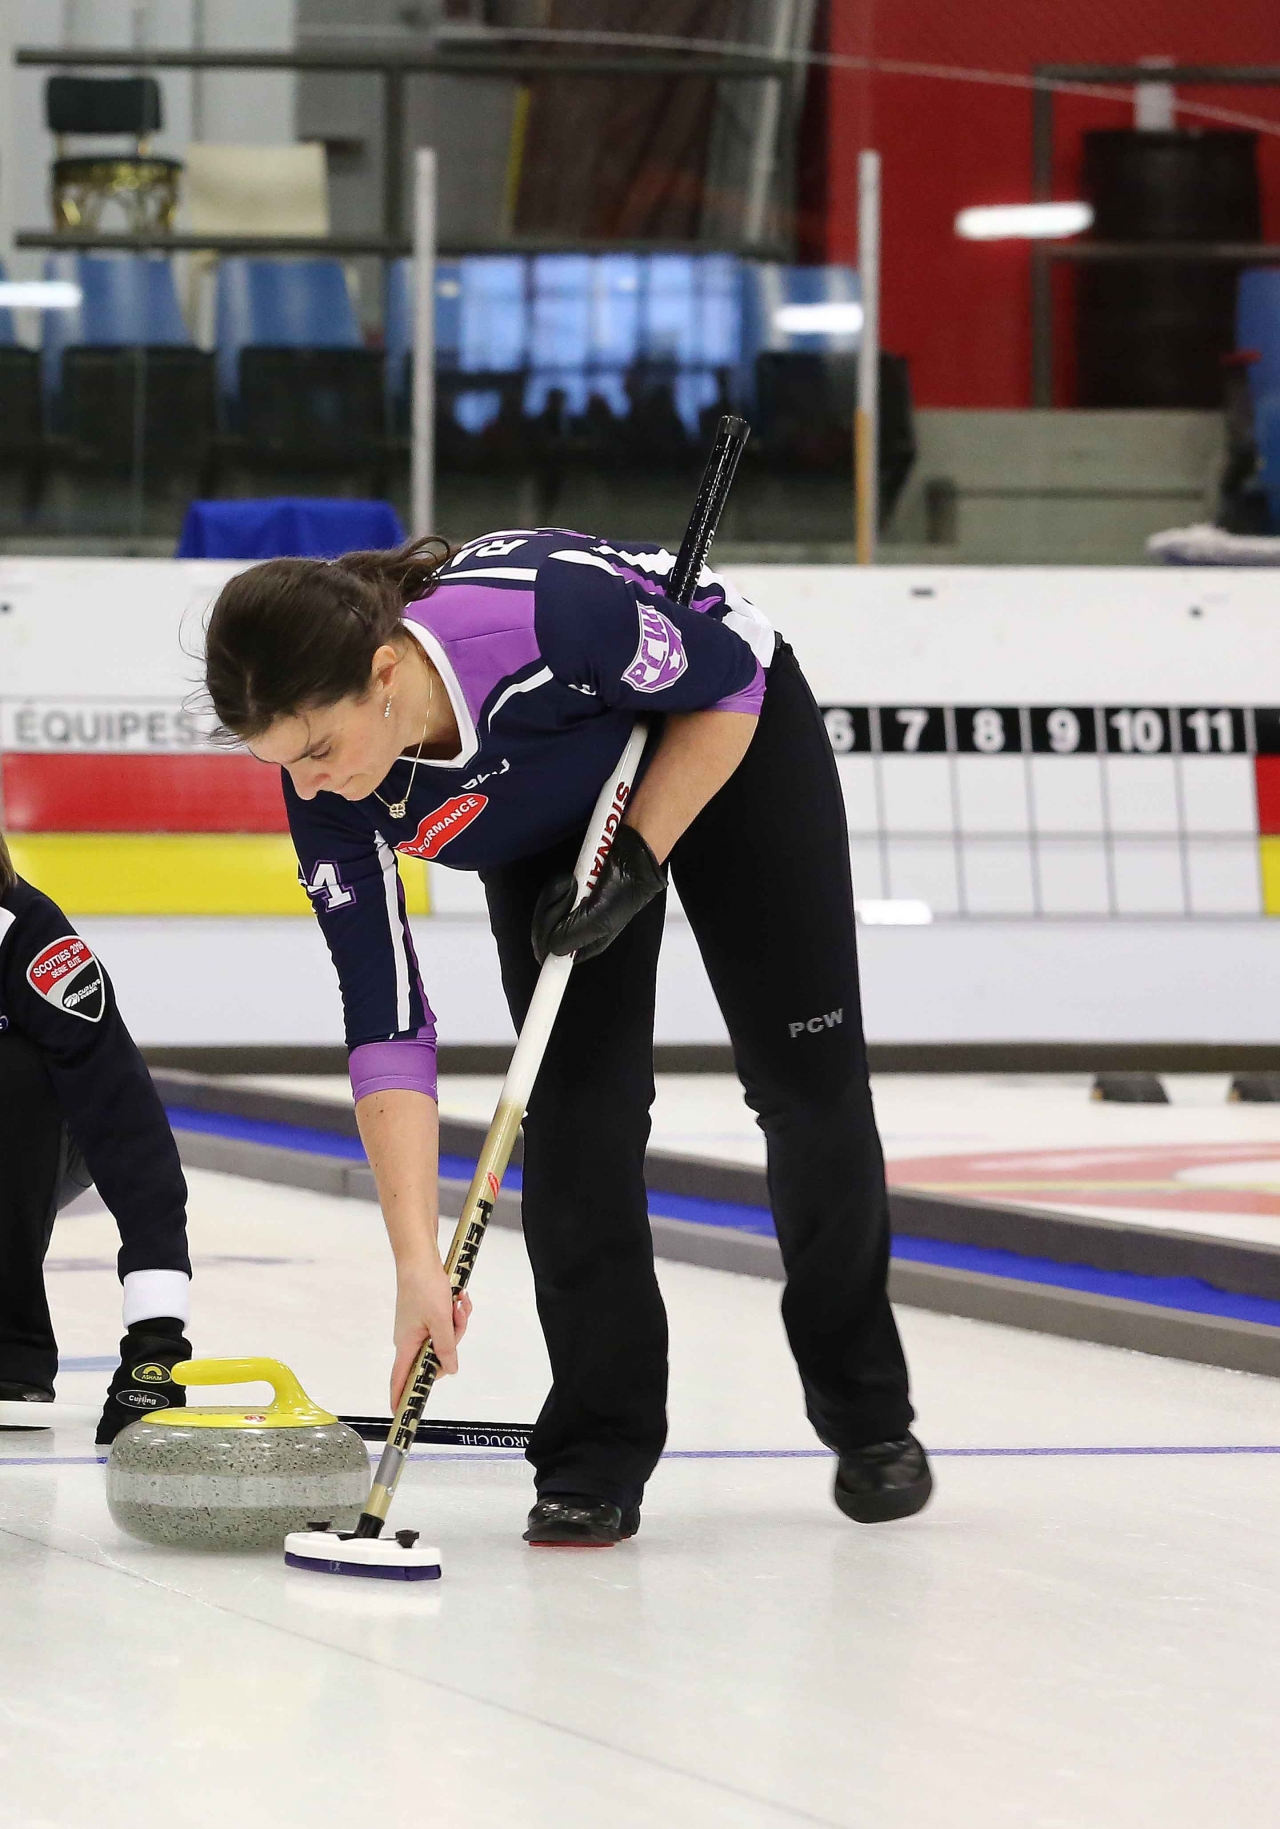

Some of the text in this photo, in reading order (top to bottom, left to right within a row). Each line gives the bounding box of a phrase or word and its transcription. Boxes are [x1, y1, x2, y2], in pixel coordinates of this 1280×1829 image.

[824, 708, 1235, 753] 6 7 8 9 10 11
[584, 781, 631, 892] SIGNA
[33, 948, 71, 978] SCOTTIES
[787, 1007, 843, 1038] PCW
